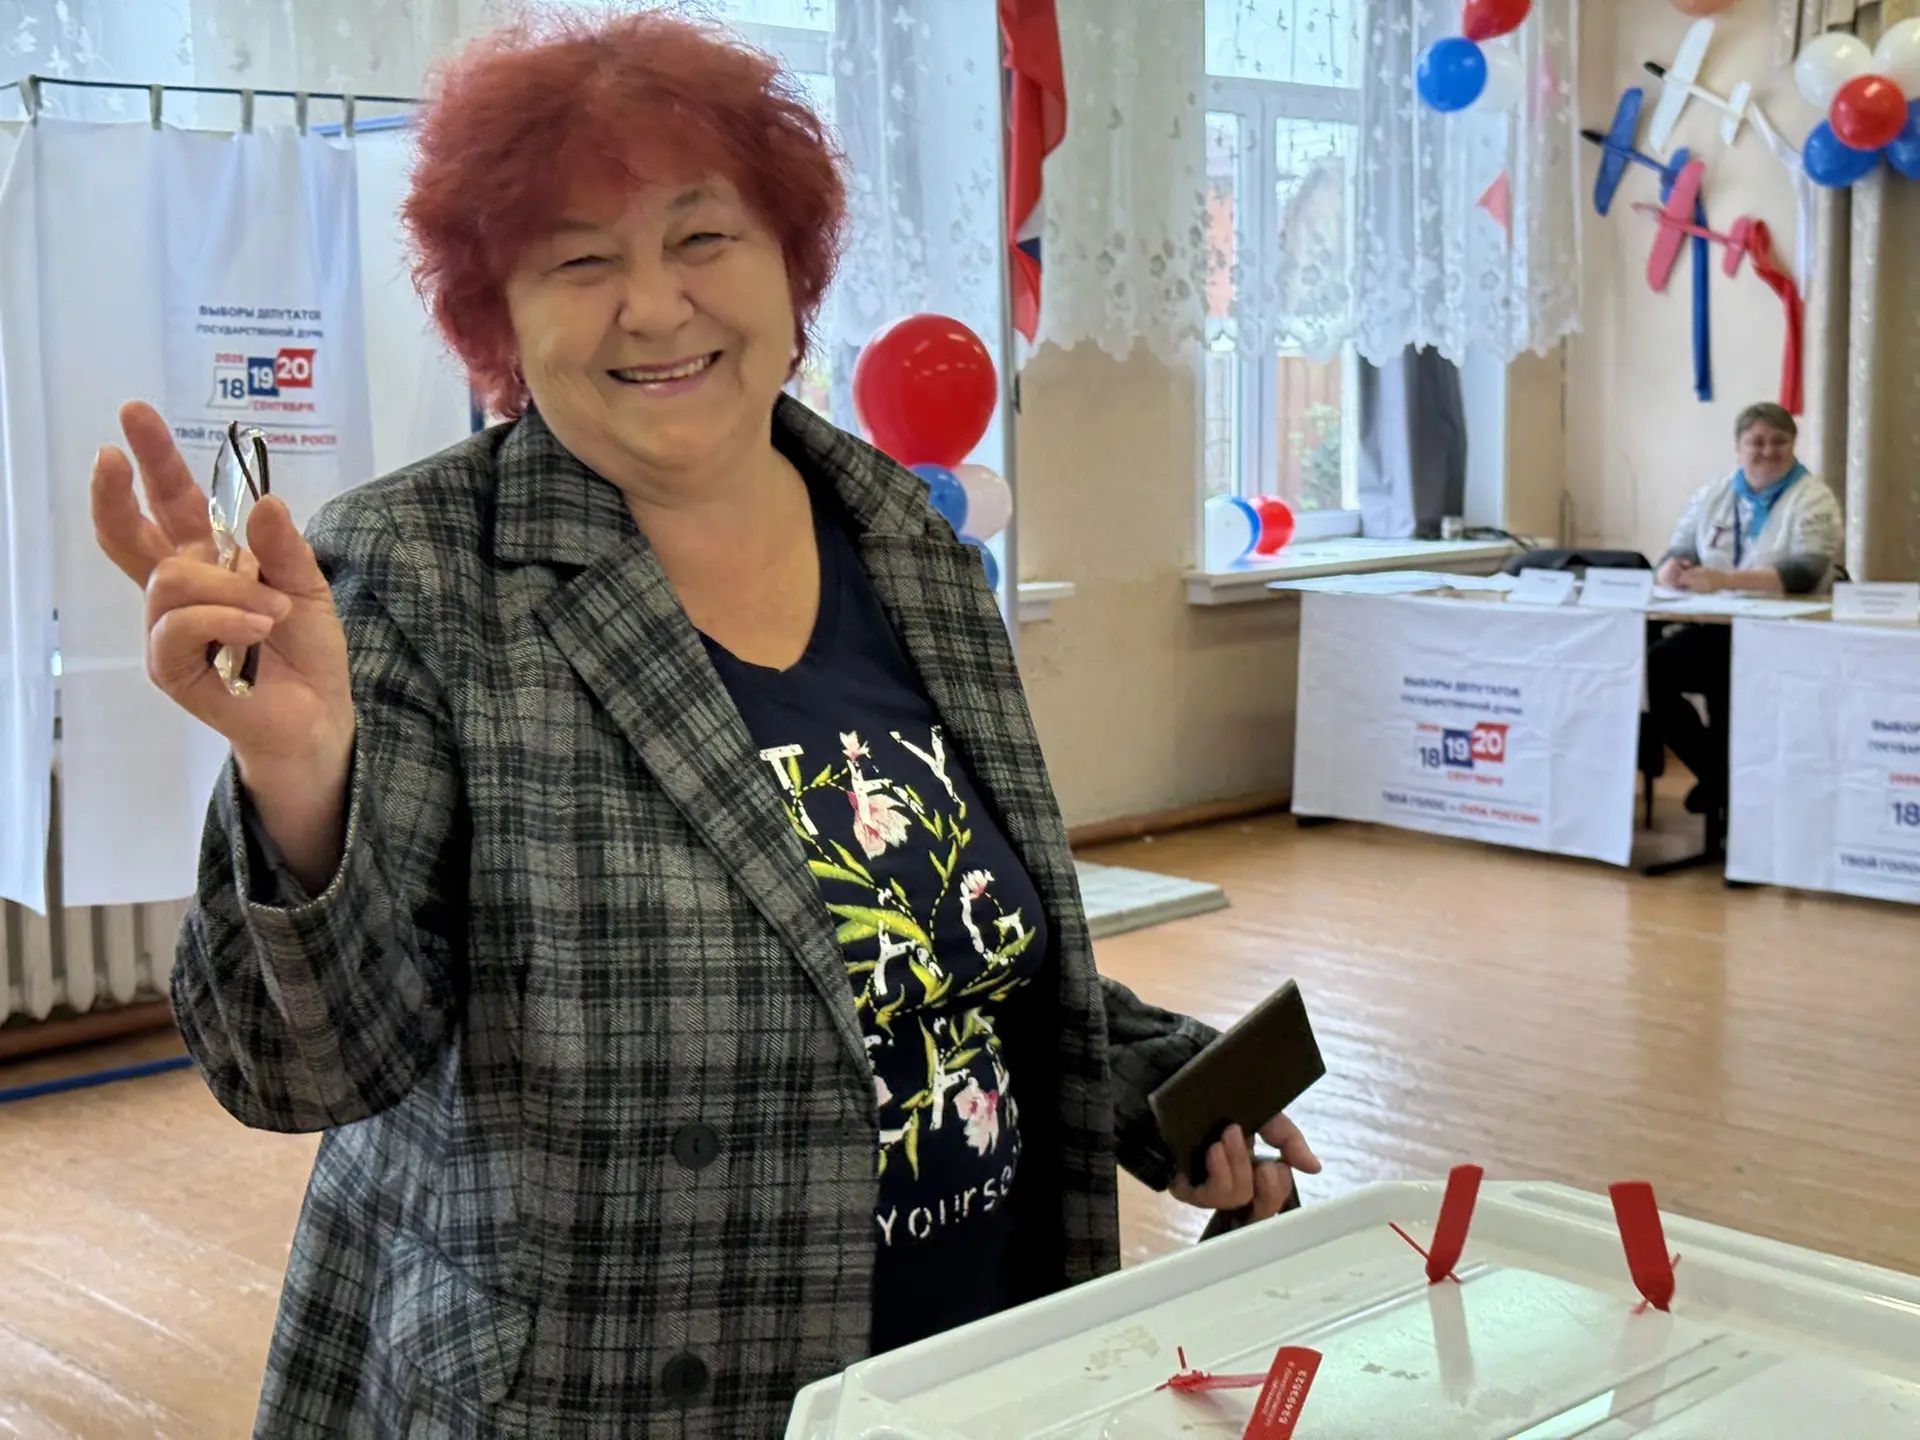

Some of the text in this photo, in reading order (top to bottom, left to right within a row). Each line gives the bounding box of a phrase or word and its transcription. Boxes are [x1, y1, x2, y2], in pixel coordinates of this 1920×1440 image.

[199, 305, 255, 318] ВЫБОРЫ
[219, 357, 310, 399] 18 19 20
[1419, 729, 1503, 769] 18 19 20
[1892, 801, 1920, 826] 18
